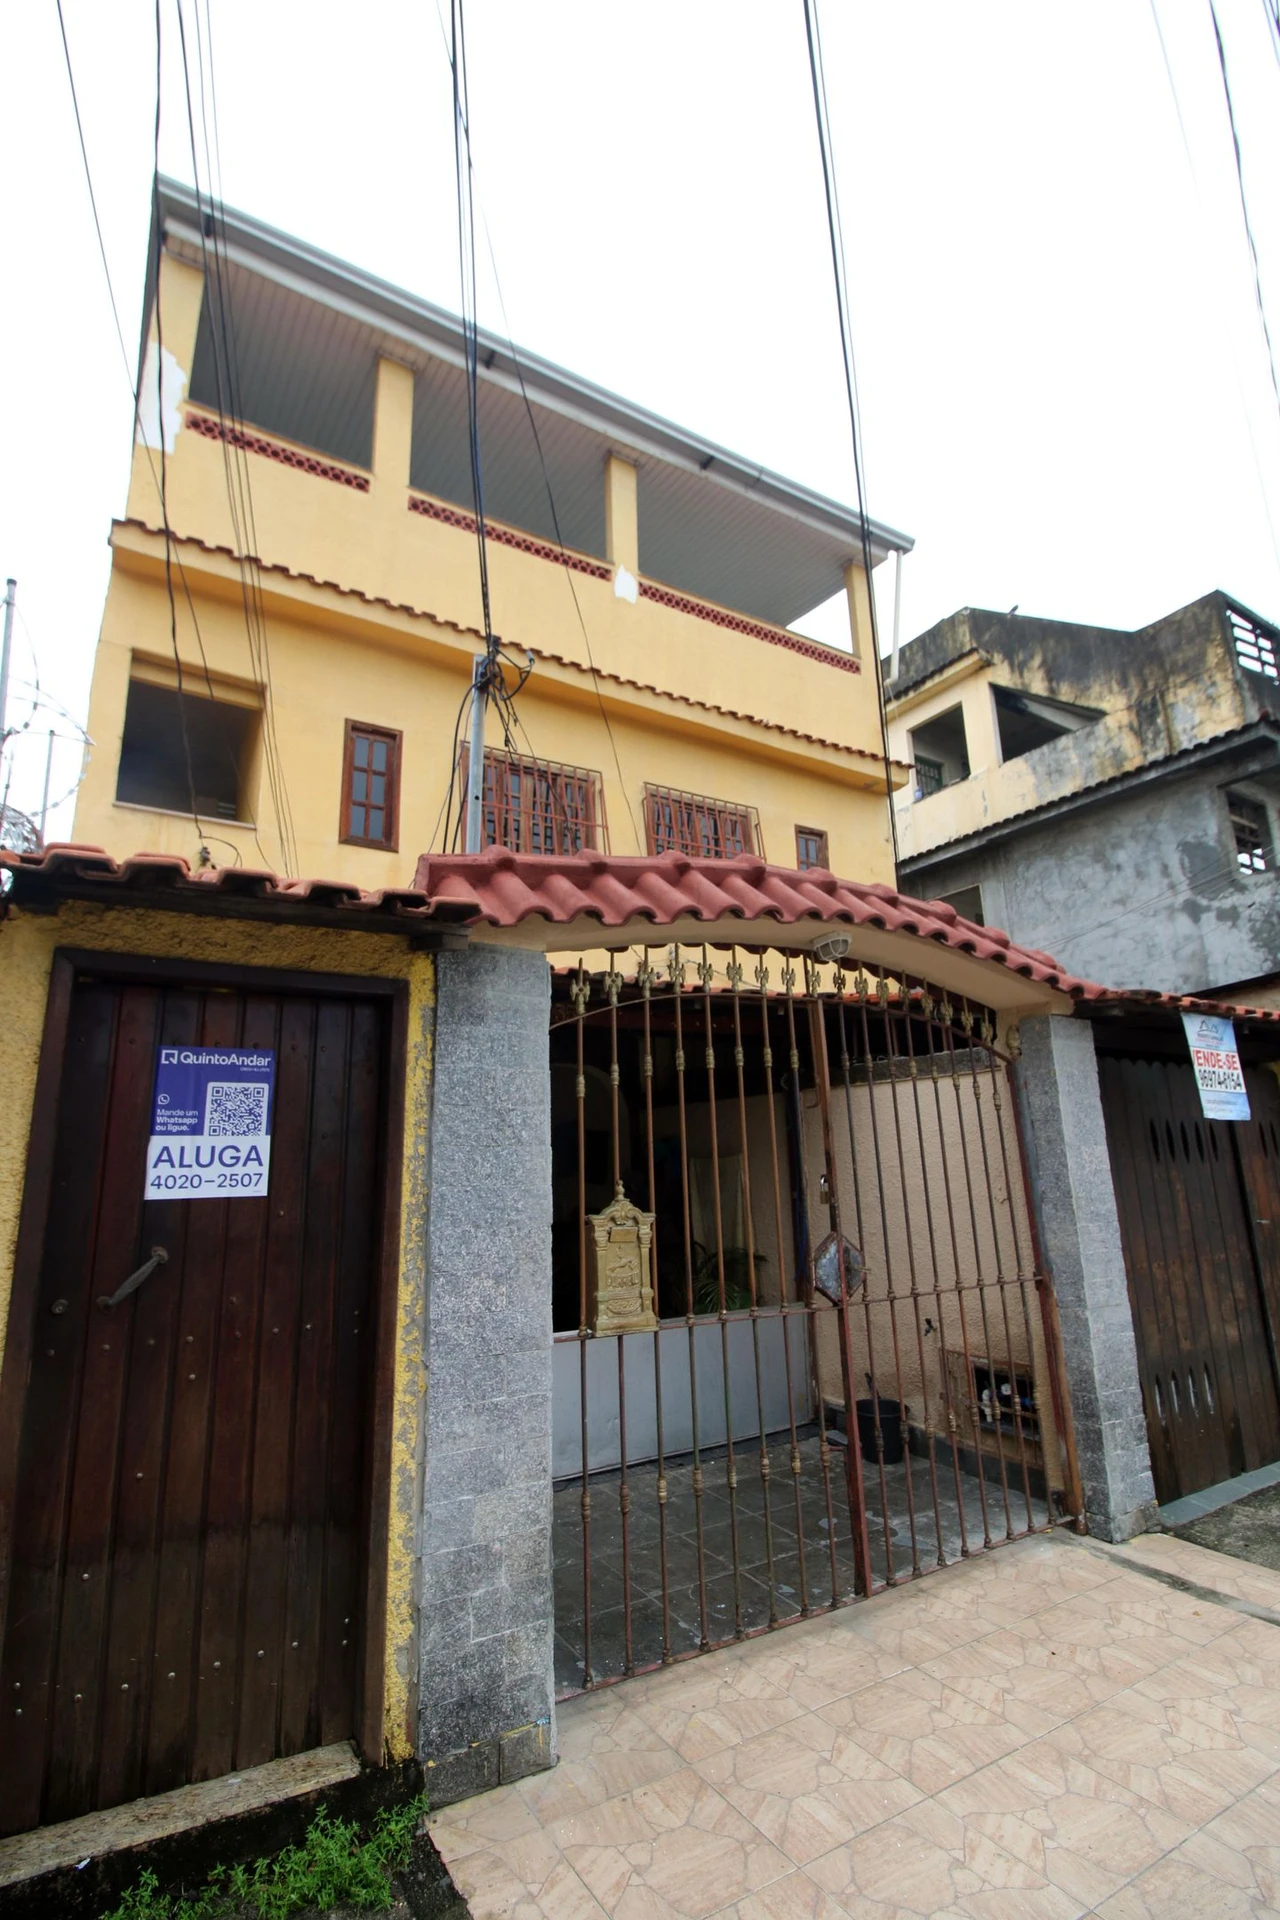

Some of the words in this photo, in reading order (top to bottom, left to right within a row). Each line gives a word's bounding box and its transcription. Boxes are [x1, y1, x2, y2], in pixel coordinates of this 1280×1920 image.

[180, 1051, 271, 1067] QuintoAndar
[156, 1108, 184, 1116] Mande
[156, 1116, 198, 1125] Whatsapp
[167, 1123, 190, 1132] ligue.
[152, 1145, 264, 1169] ALUGA
[150, 1173, 264, 1190] 4020-2507
